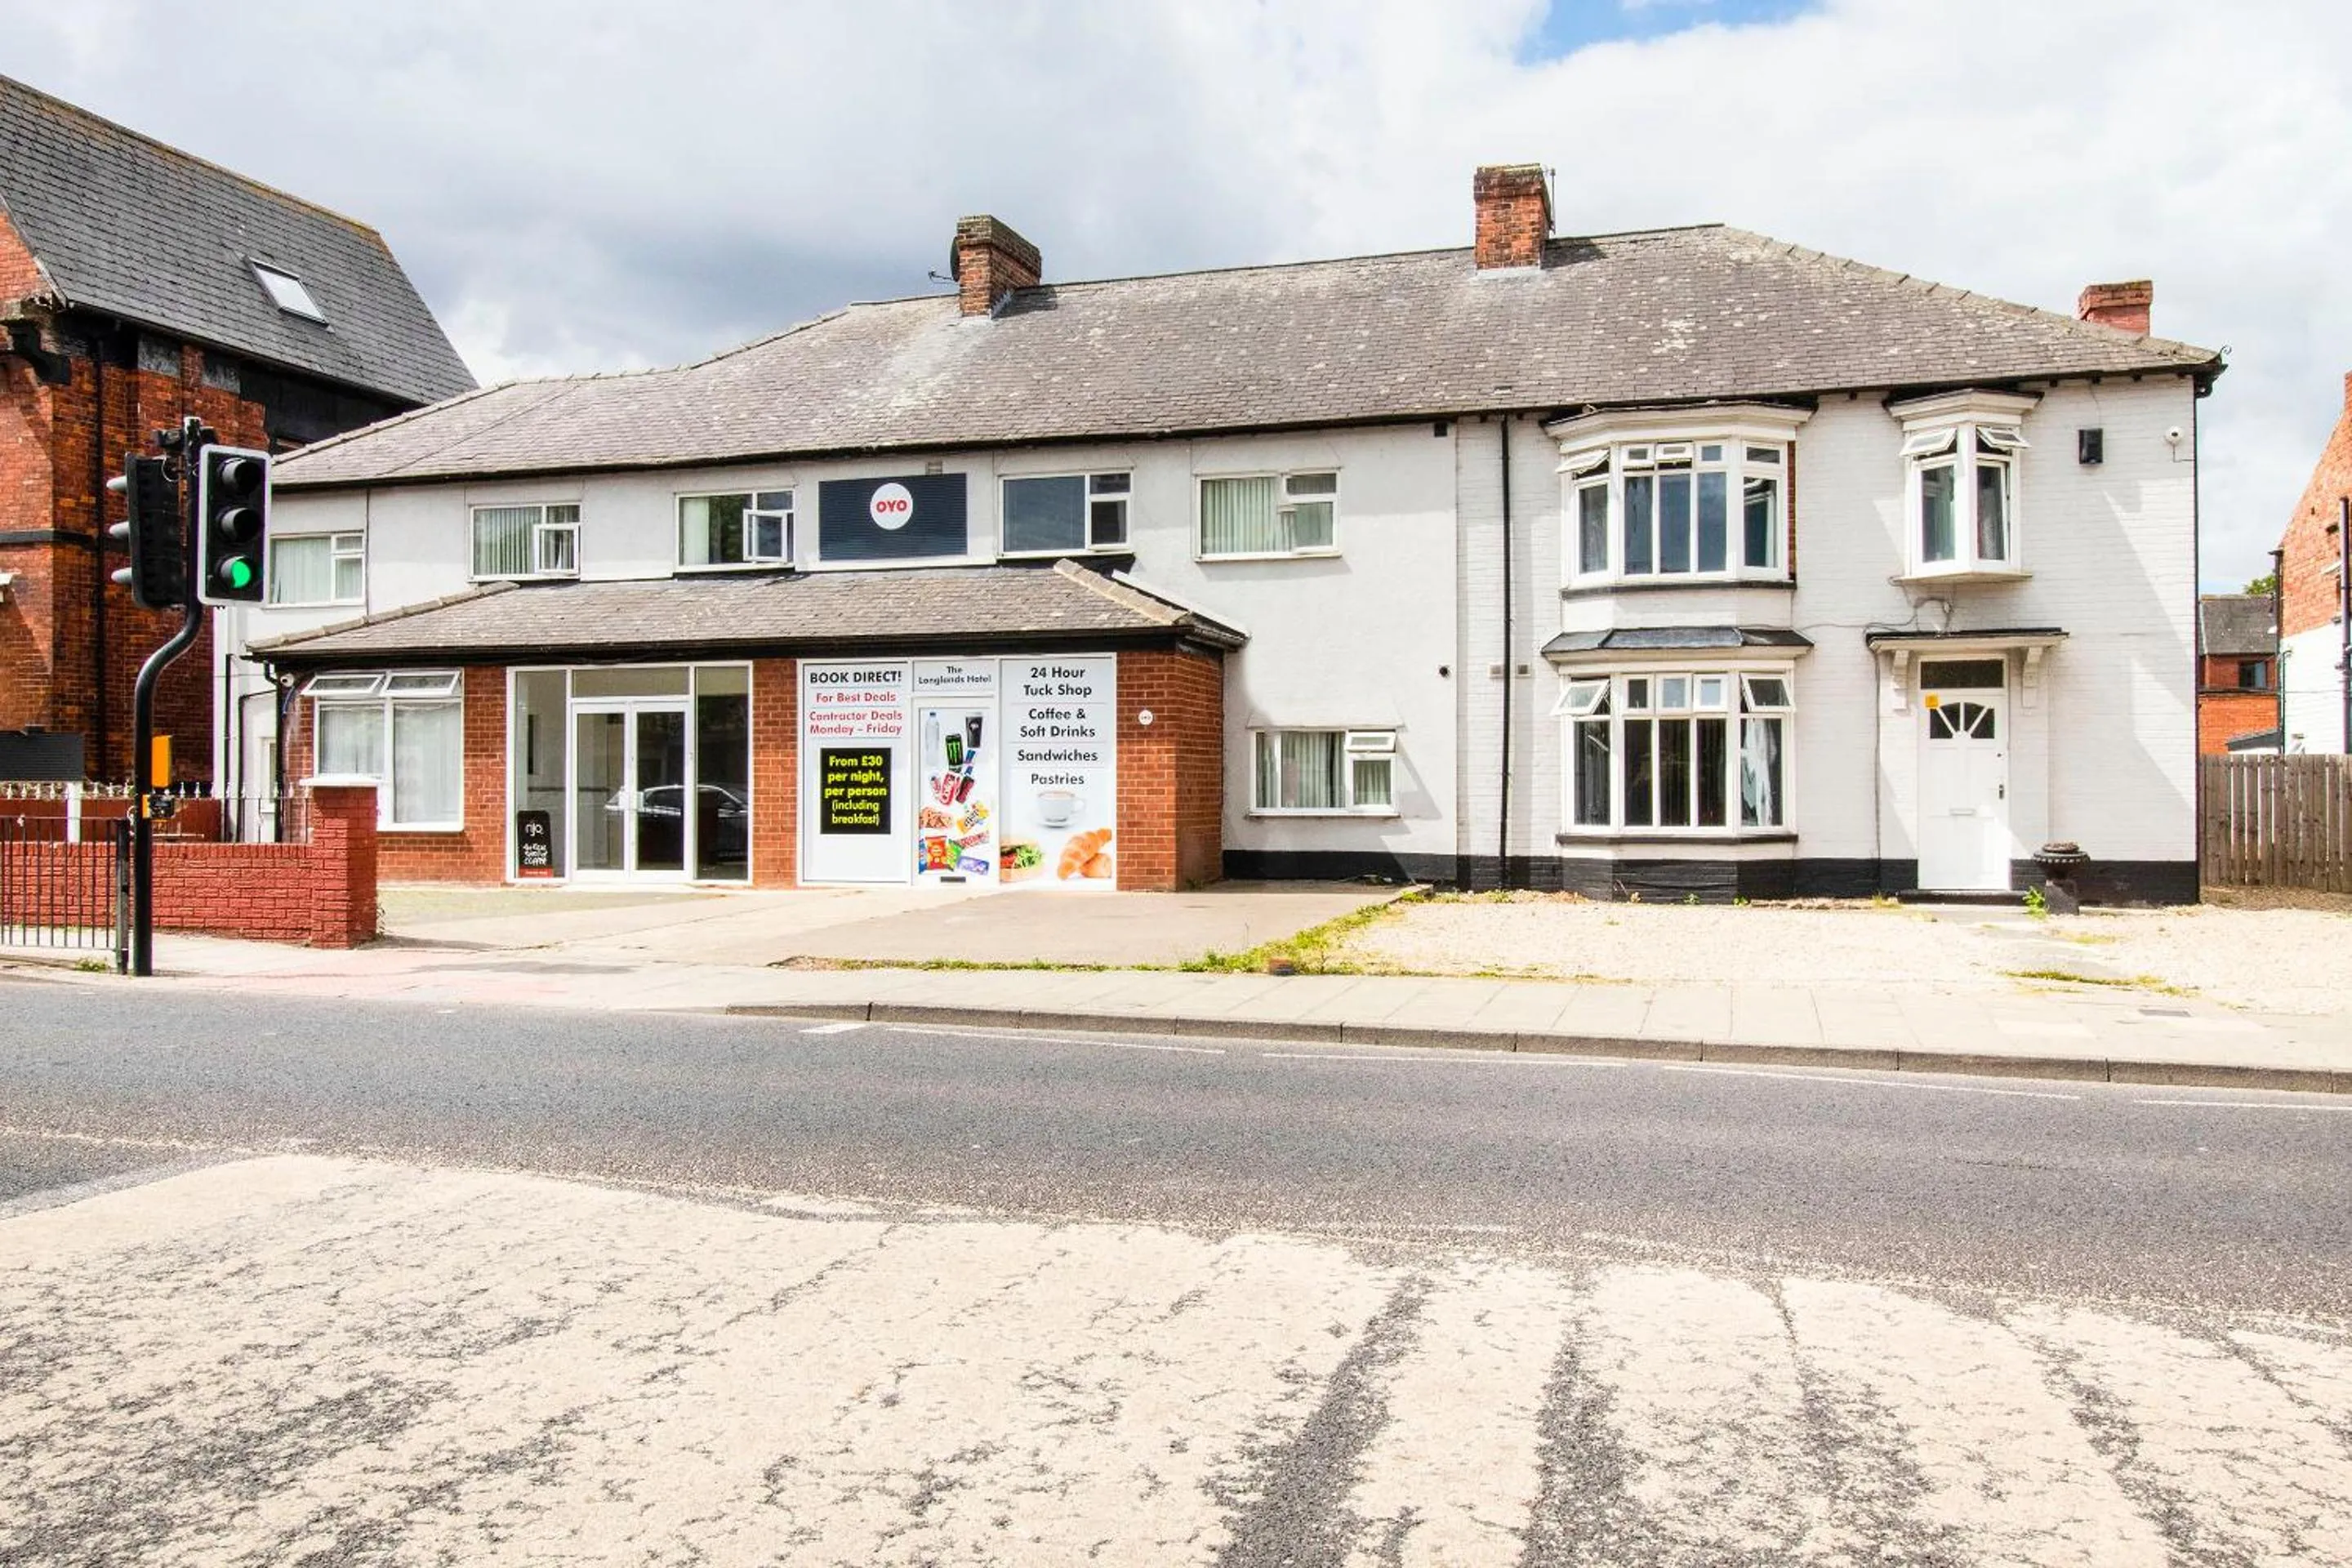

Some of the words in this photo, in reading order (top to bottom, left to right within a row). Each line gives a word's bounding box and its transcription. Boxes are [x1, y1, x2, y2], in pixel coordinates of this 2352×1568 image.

[876, 500, 906, 513] OYO
[946, 666, 963, 674] The
[1031, 667, 1046, 678] 24
[1052, 666, 1085, 678] Hour
[810, 672, 849, 684] BOOK
[853, 670, 902, 683] DIRECT!
[967, 675, 991, 683] Hotel
[1023, 684, 1053, 695] Tuck
[1058, 684, 1092, 697] Shop
[817, 693, 833, 702] For
[837, 693, 860, 702] Best
[865, 692, 896, 702] Deals
[809, 711, 866, 720] Contractor
[871, 710, 902, 720] Deals
[1028, 708, 1071, 719] Coffee
[1076, 709, 1086, 719] &
[810, 724, 853, 735] Monday
[866, 724, 902, 735] Friday
[1020, 726, 1045, 737] Soft
[1050, 726, 1095, 737] Drinks
[829, 755, 858, 766] From
[862, 755, 883, 766] £30
[1018, 749, 1098, 761] Sandwiches
[828, 773, 848, 784] per
[851, 770, 884, 783] night,
[1031, 773, 1085, 784] Pastries
[825, 788, 844, 799] per
[848, 788, 887, 799] person
[832, 800, 880, 813] (including
[832, 813, 880, 826] breakfast)
